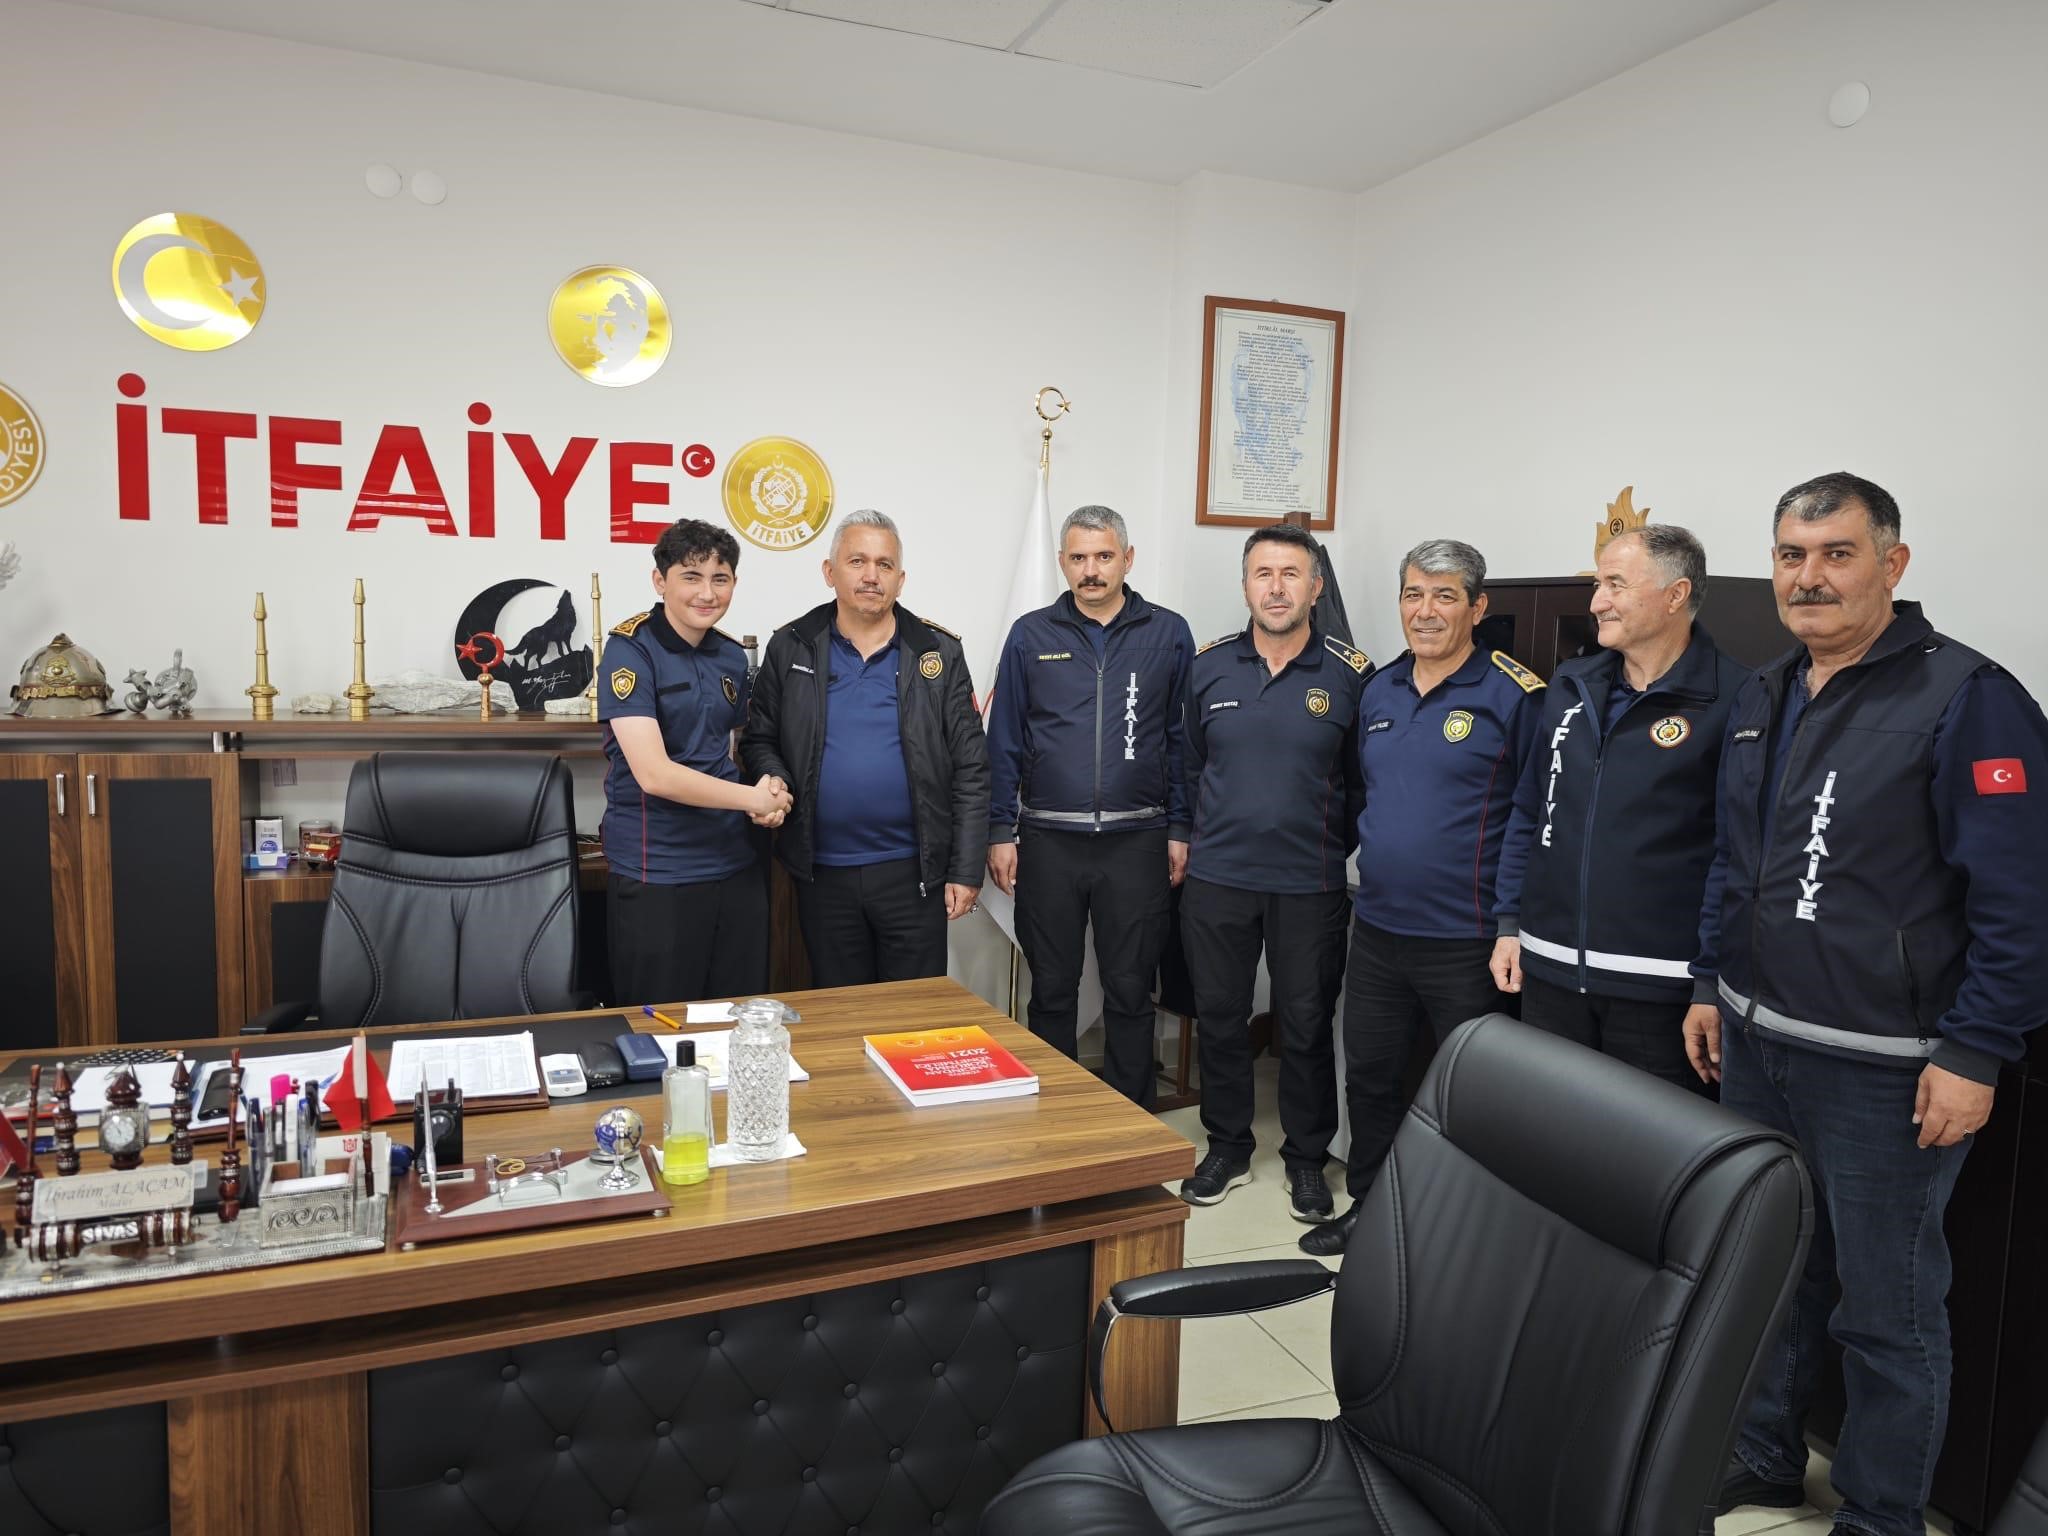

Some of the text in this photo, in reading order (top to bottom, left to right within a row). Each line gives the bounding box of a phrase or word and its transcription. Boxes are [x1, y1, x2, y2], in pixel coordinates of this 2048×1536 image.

[116, 373, 673, 545] İTFAİYE
[752, 523, 806, 544] İTFAİYE
[1123, 672, 1139, 760] İTFAİYE
[1796, 770, 1838, 922] İTFAİYE
[948, 1048, 988, 1058] 2021
